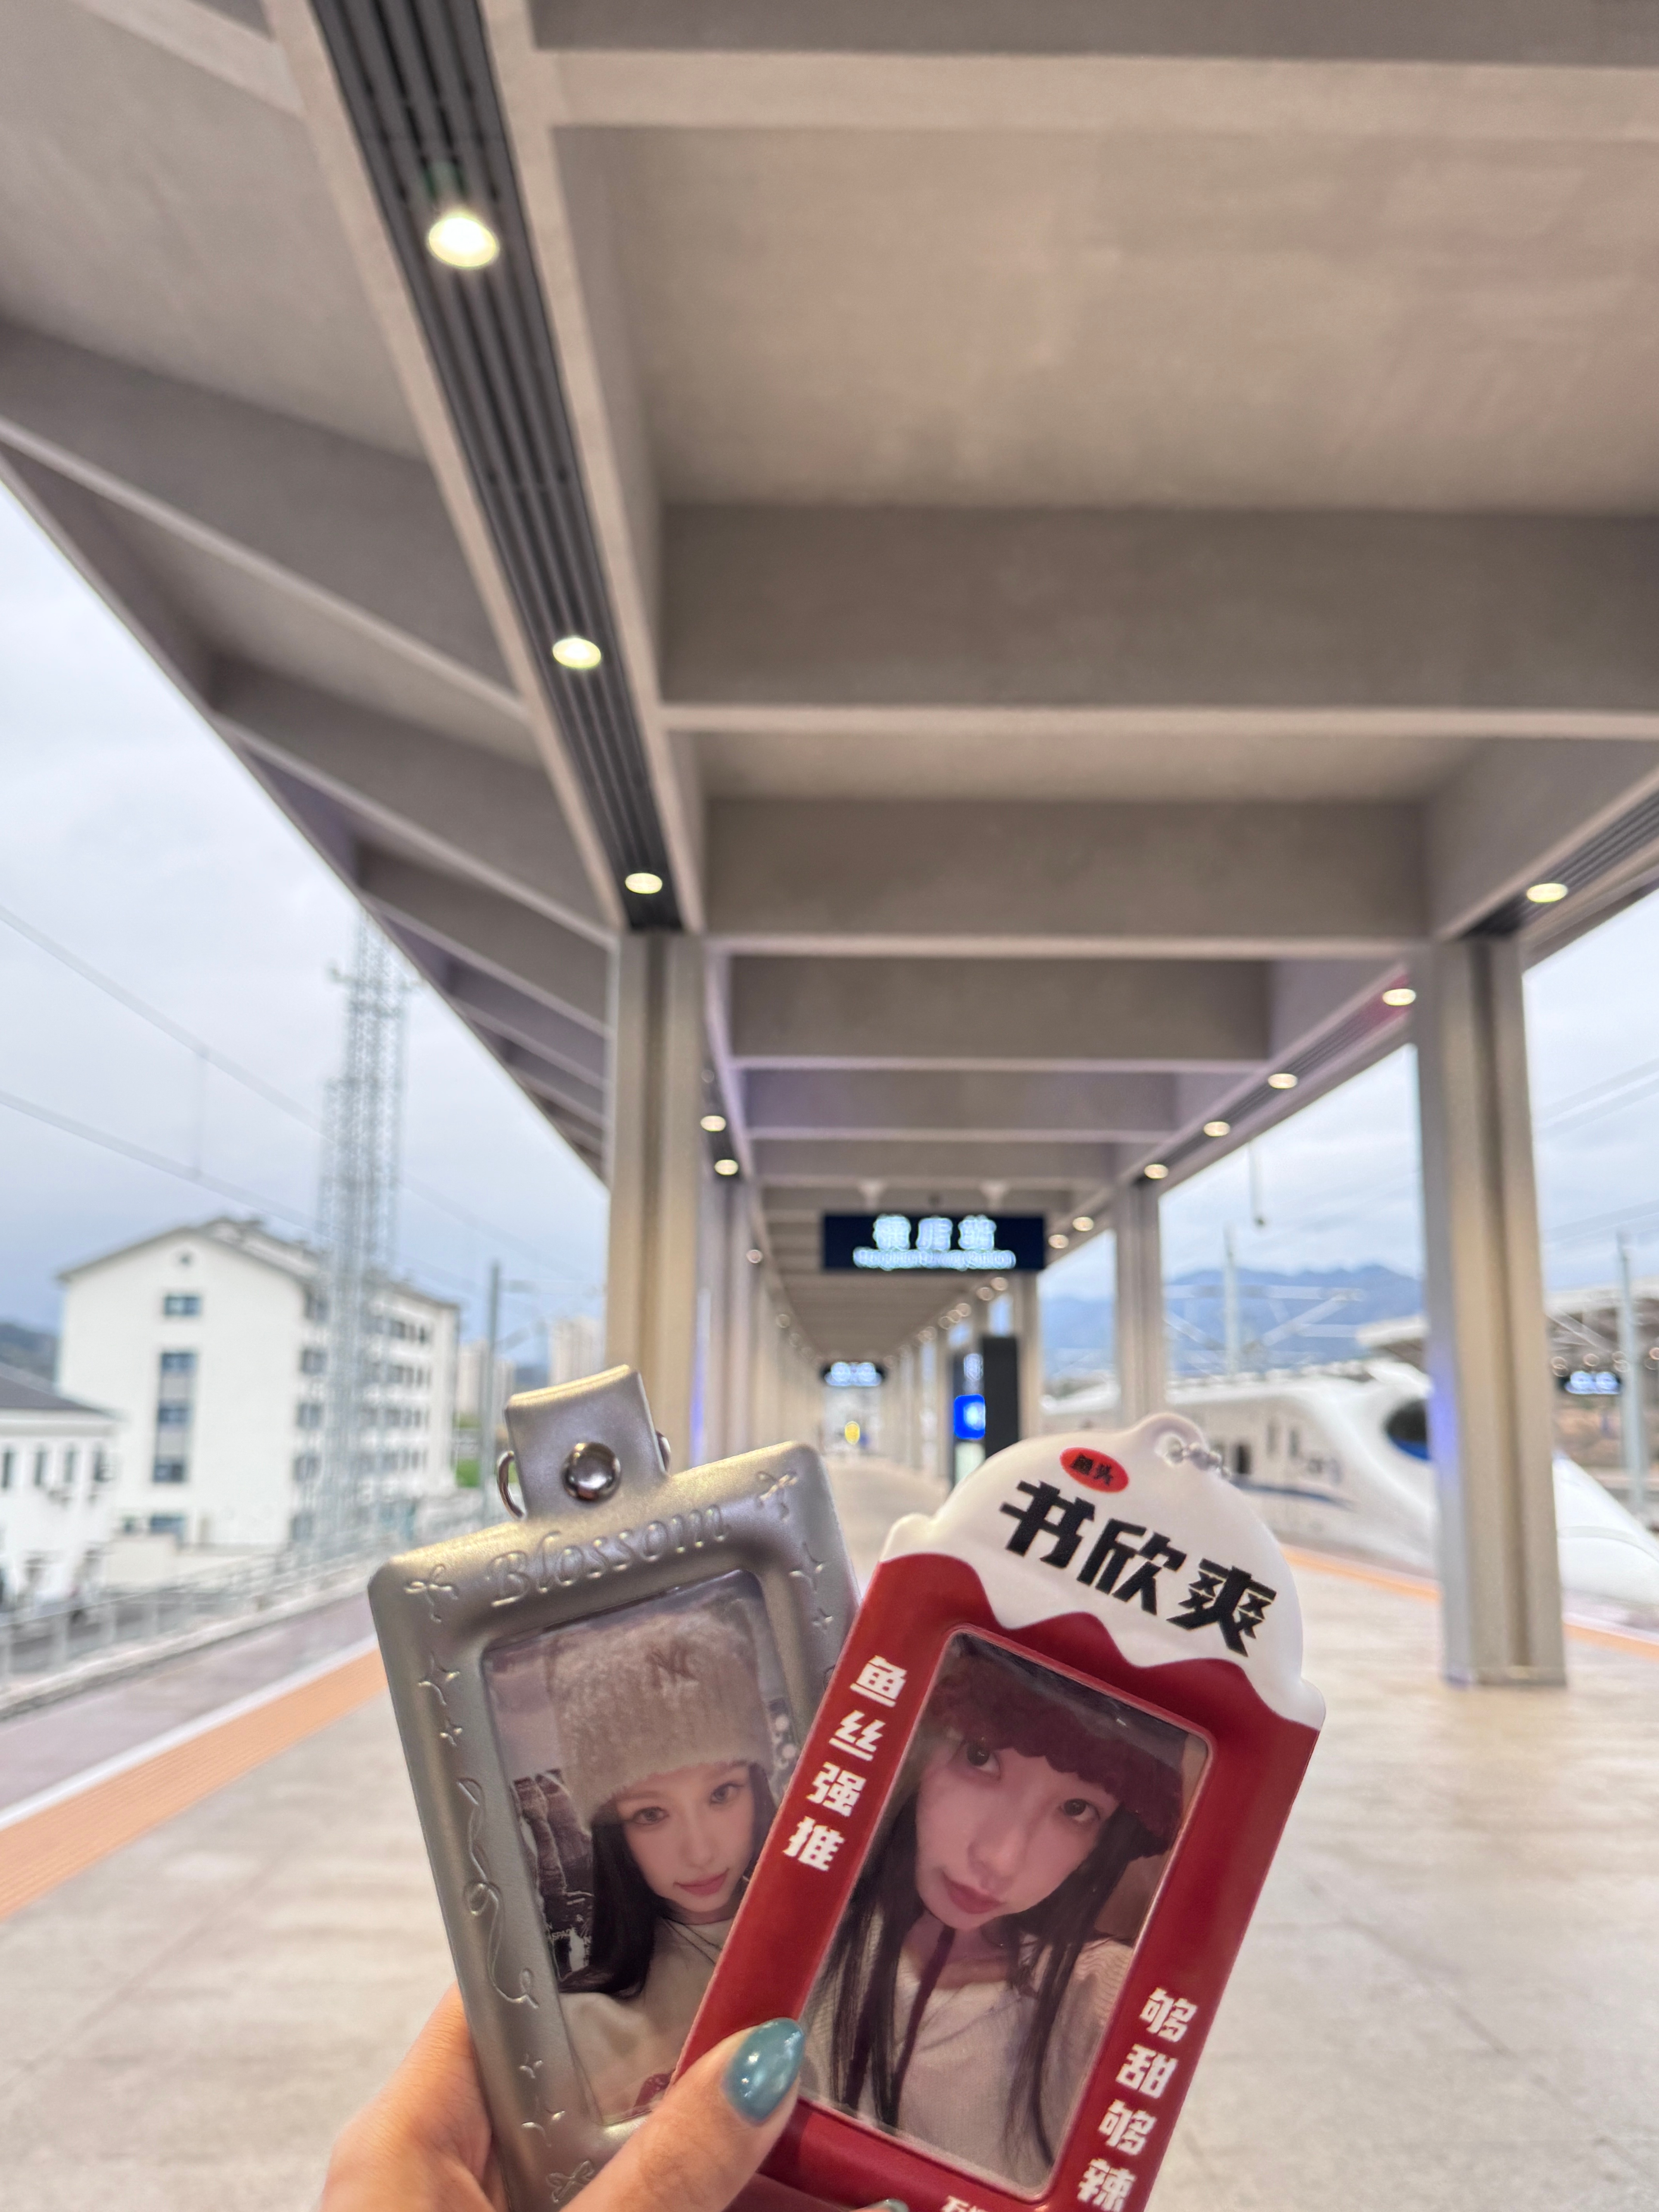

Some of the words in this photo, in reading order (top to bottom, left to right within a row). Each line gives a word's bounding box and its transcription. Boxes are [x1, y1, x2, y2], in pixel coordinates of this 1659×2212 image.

[999, 1480, 1277, 1657] 书欣爽
[782, 1655, 907, 1872] 鱼丝强推
[1077, 1987, 1198, 2212] 够甜够辣
